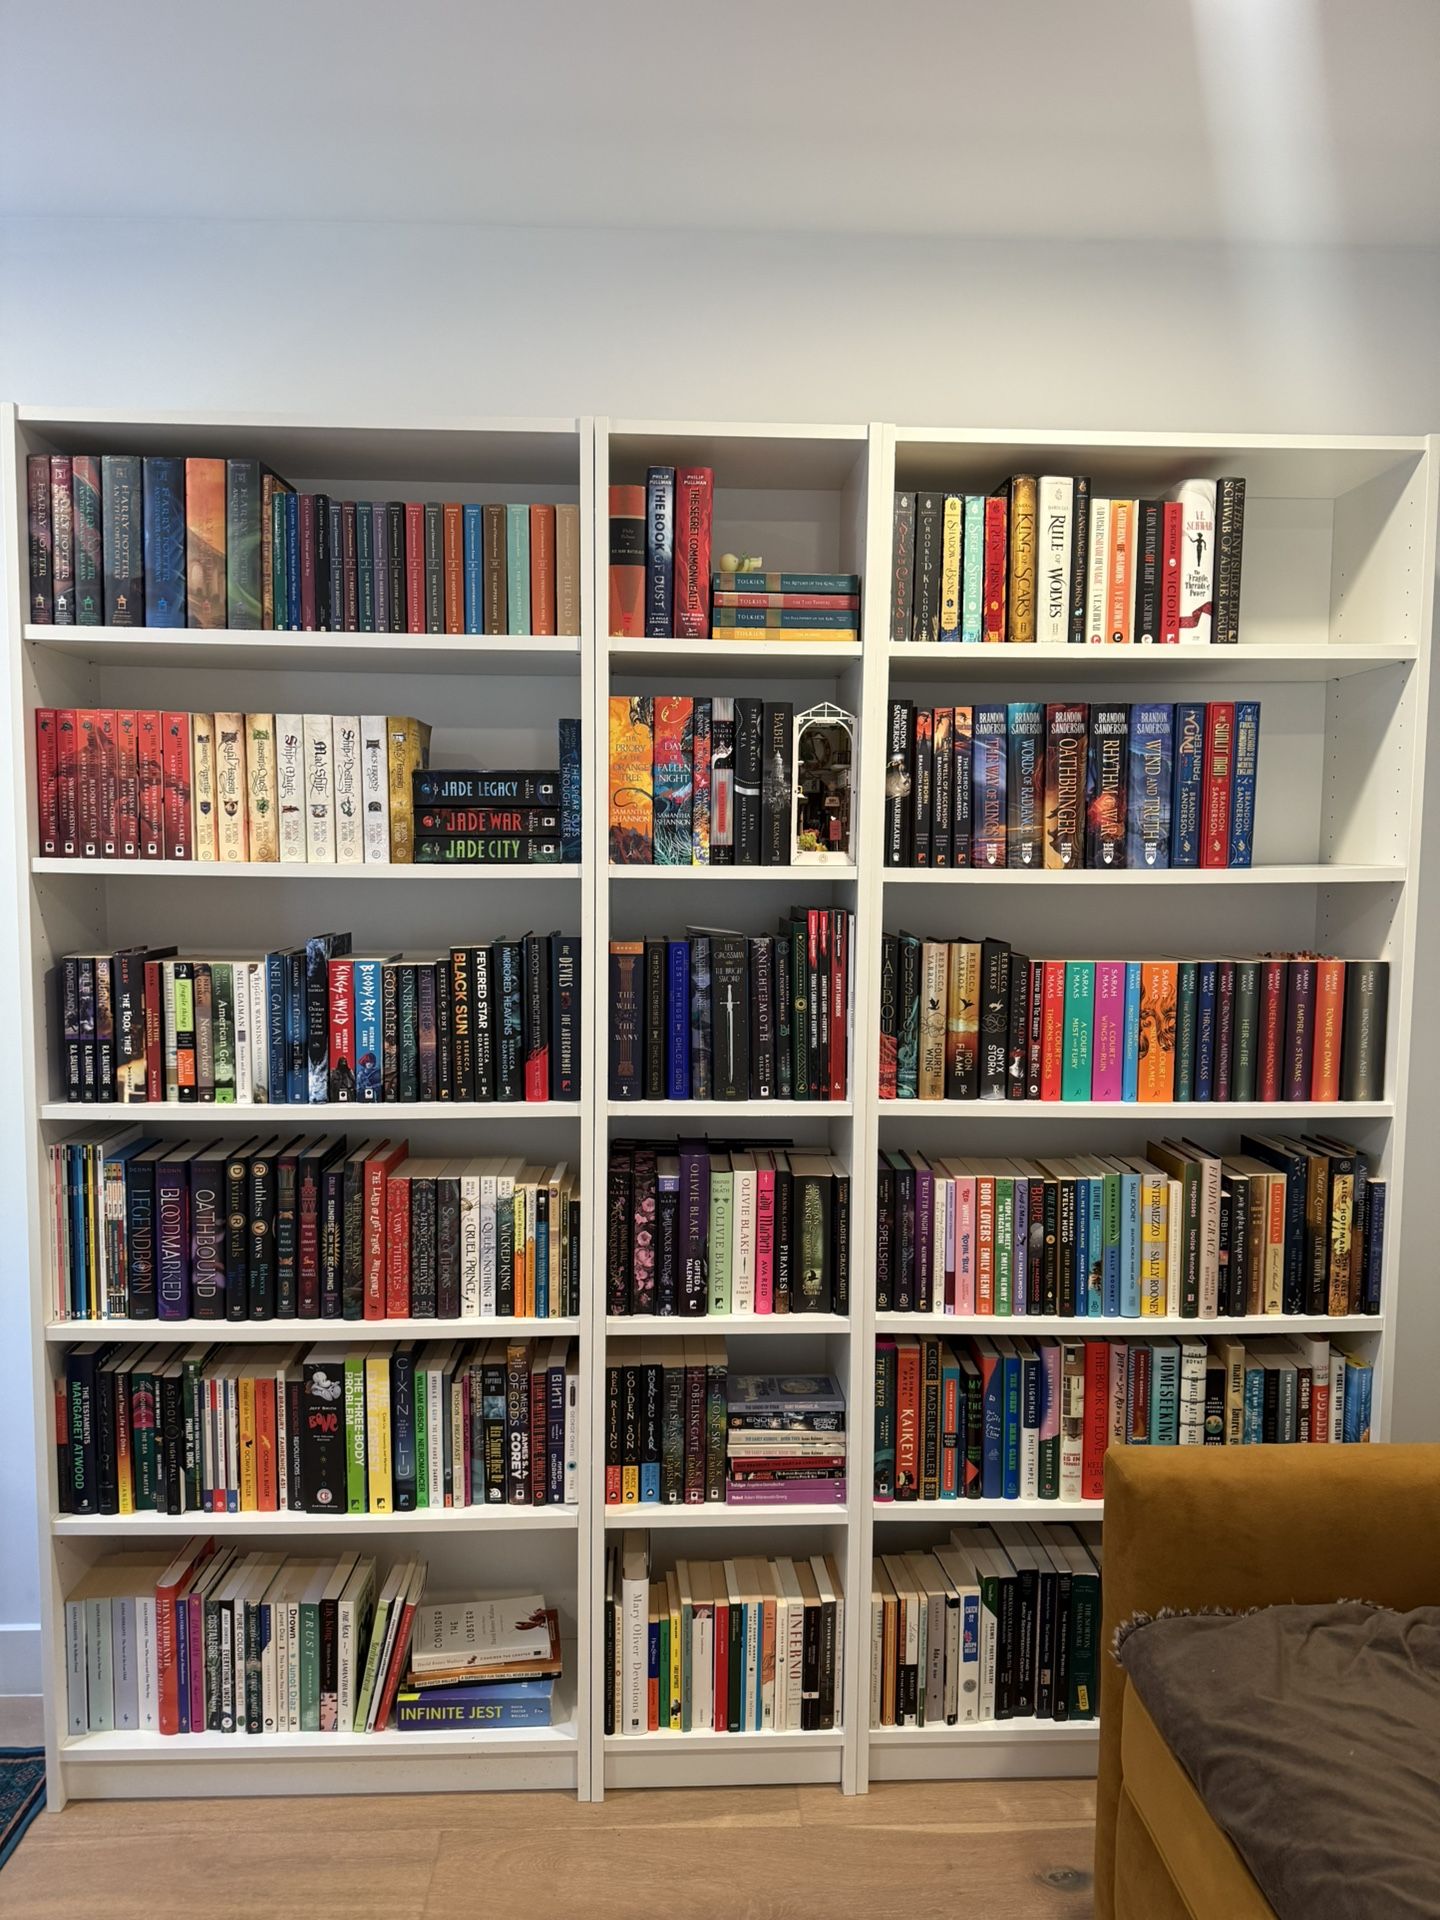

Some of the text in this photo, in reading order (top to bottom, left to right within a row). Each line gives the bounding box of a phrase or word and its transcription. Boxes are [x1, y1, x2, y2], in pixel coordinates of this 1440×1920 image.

[121, 485, 129, 580] HARRY POTTER
[1222, 481, 1235, 533] SCHWAB
[654, 487, 666, 608] THE BOOK OF DUST
[688, 488, 700, 609] THE SECRET COMMONWEALTH
[1016, 513, 1034, 617] KING SCARS
[1048, 515, 1066, 618] RULE WOLVES
[564, 598, 572, 617] END
[1166, 570, 1178, 628] VICIOUS
[773, 713, 784, 752] BABEL
[310, 739, 328, 799] Mad Ship
[441, 781, 518, 796] JADE LEGACY
[562, 763, 570, 805] THROUGH
[571, 764, 579, 781] THE
[1021, 739, 1034, 833] WORDS OF RADIANCE
[1057, 738, 1078, 836] OATHBRINGER
[1101, 740, 1119, 837] RHYTHM WAR
[1144, 740, 1161, 839] WIND AND TRUTH
[446, 840, 520, 858] JADE CITY
[447, 813, 522, 831] JADE WAR
[572, 813, 580, 837] CUTS
[454, 953, 468, 1035] BLACK SUN
[477, 951, 487, 1028] FEVERED STAR
[558, 958, 572, 987] DEVILS
[218, 1000, 228, 1073] American Gods
[402, 970, 414, 1047] SUNBRINGER
[201, 1018, 209, 1077] Neverwhere
[561, 1014, 571, 1074] JOE ABERCROMBIE
[955, 1043, 964, 1076] FLAME
[988, 1045, 996, 1075] STORM
[996, 1048, 1004, 1072] ONYX
[1201, 1008, 1210, 1080] THRONE GLASS
[1294, 1048, 1302, 1081] STORMS
[252, 1162, 268, 1258] Ruthless Vows
[690, 1163, 698, 1241] OLIVIE BLAKE
[1189, 1181, 1197, 1217] trespasses
[1207, 1166, 1217, 1258] FINDING GRACE
[132, 1189, 152, 1294] LEGENDBORN
[161, 1189, 181, 1300] BLOODMARKED
[195, 1190, 216, 1297] OATHBOUND
[499, 1223, 511, 1290] WICKED KING
[780, 1245, 788, 1294] PIRANESI
[980, 1183, 990, 1298] BOOK LOVERS EMILY HENRY
[1150, 1180, 1160, 1315] INTERMEZZO SALLY ROONEY
[1188, 1253, 1196, 1283] kennedy
[693, 1260, 701, 1284] GIFTED
[345, 1372, 353, 1424] PROBLEM
[510, 1373, 519, 1425] OF GODS
[520, 1373, 528, 1424] THE MERCY
[1095, 1350, 1105, 1455] THE BOOK OF LOVE
[1159, 1356, 1175, 1441] HOMESEEKING
[1232, 1364, 1243, 1393] matrix
[72, 1382, 84, 1489] MARGARET ATWOOD
[355, 1372, 364, 1466] THE THREE-BODY
[712, 1394, 721, 1450] STONE SKY
[901, 1409, 914, 1466] KAIKEYI
[926, 1349, 937, 1475] CIRCE MADELINE MILLER
[511, 1432, 521, 1478] COREY
[306, 1611, 314, 1657] TRUST
[434, 1611, 442, 1649] CONSIDER
[466, 1611, 475, 1642] LOBSTER
[631, 1594, 642, 1713] Mary Oliver Devotions
[790, 1614, 803, 1679] INFERNO
[401, 1706, 503, 1720] INFINITE JEST
